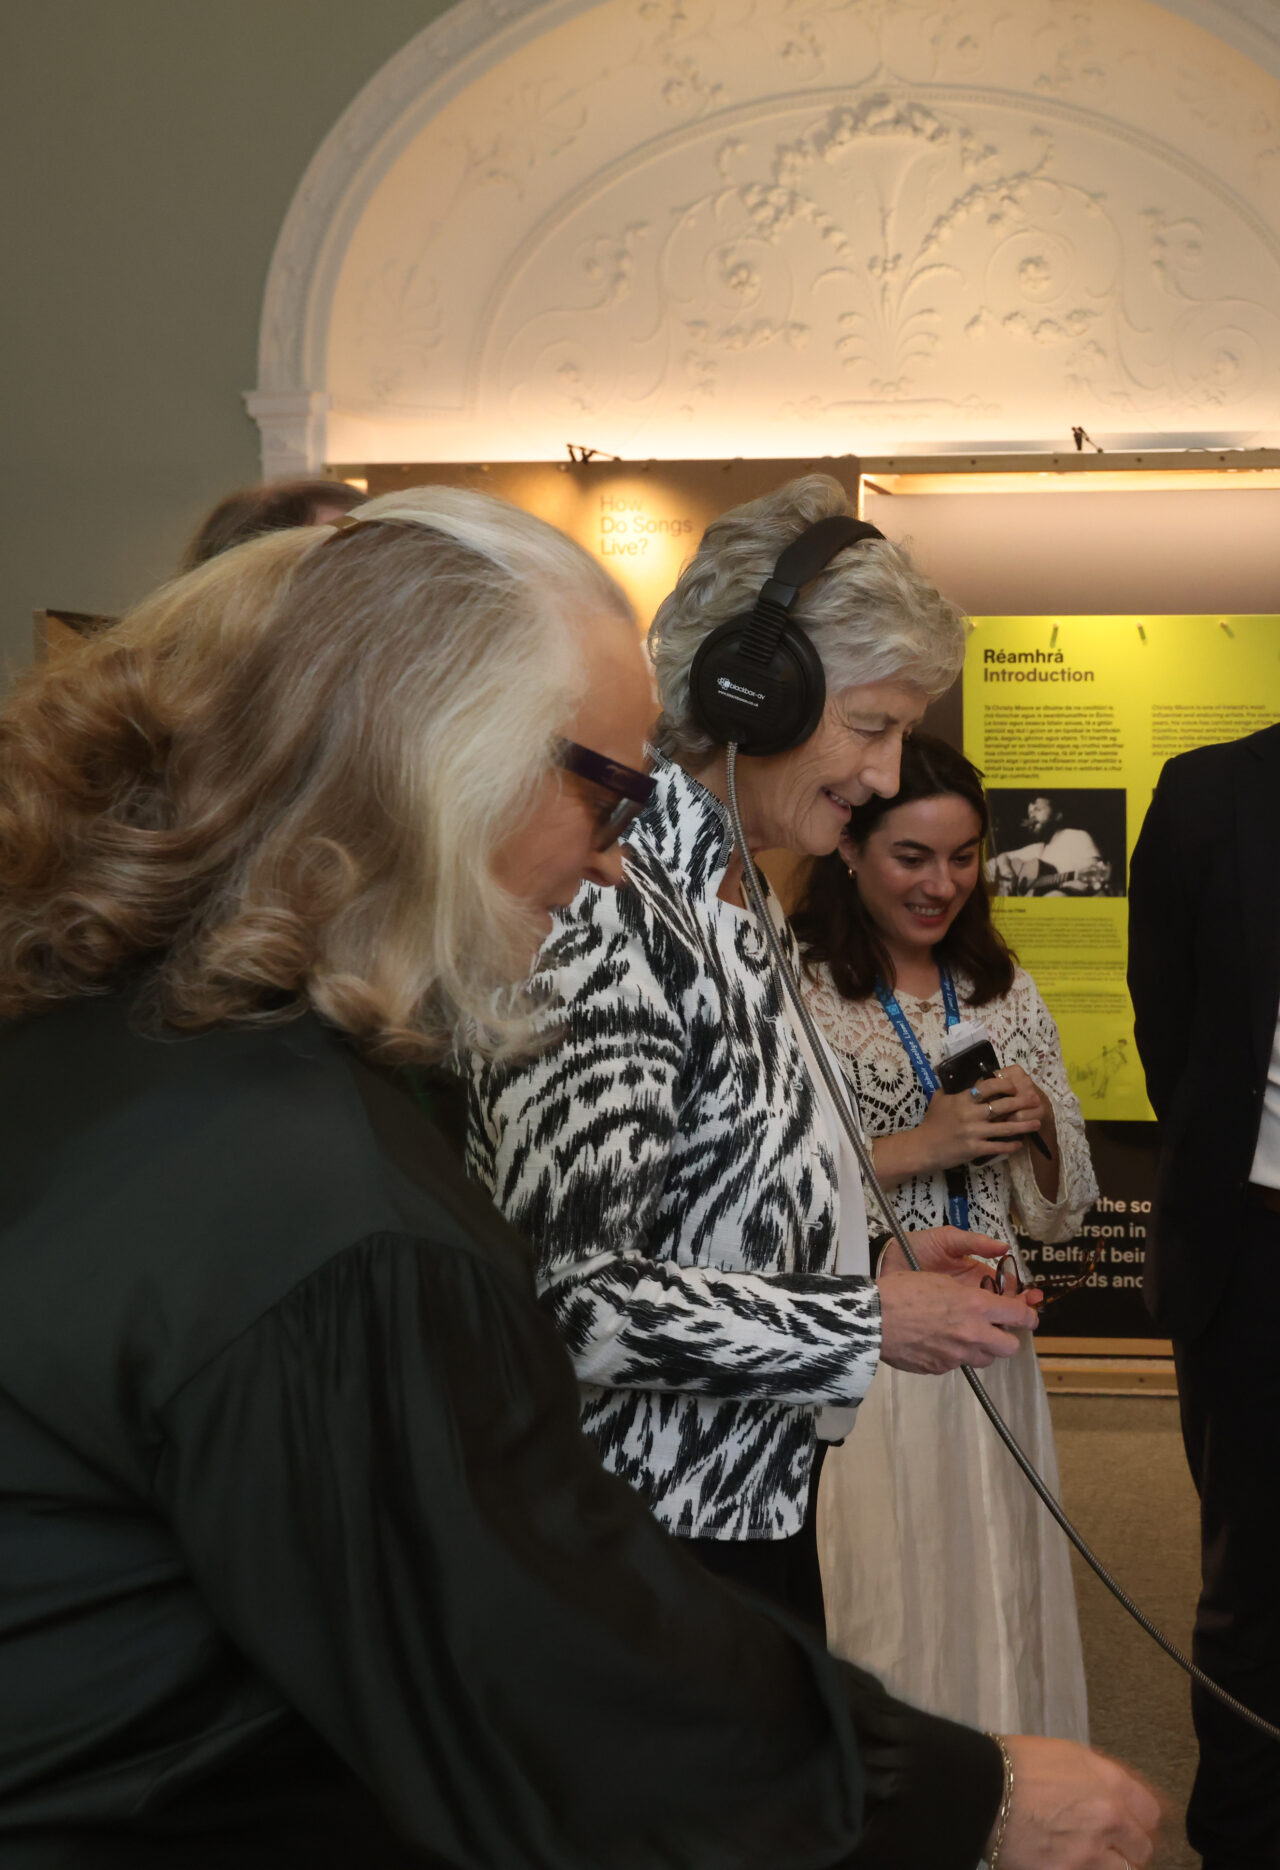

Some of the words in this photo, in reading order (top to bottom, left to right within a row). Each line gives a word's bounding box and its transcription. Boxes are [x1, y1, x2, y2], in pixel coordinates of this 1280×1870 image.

[600, 495, 642, 513] How
[601, 517, 626, 534] Do
[633, 517, 693, 537] Songs
[601, 538, 648, 556] Live?
[984, 648, 1064, 665] Réamhrá
[984, 667, 1095, 683] Introduction
[896, 1020, 911, 1039] Liom!
[1096, 1197, 1125, 1213] the
[1074, 1226, 1125, 1238] erson
